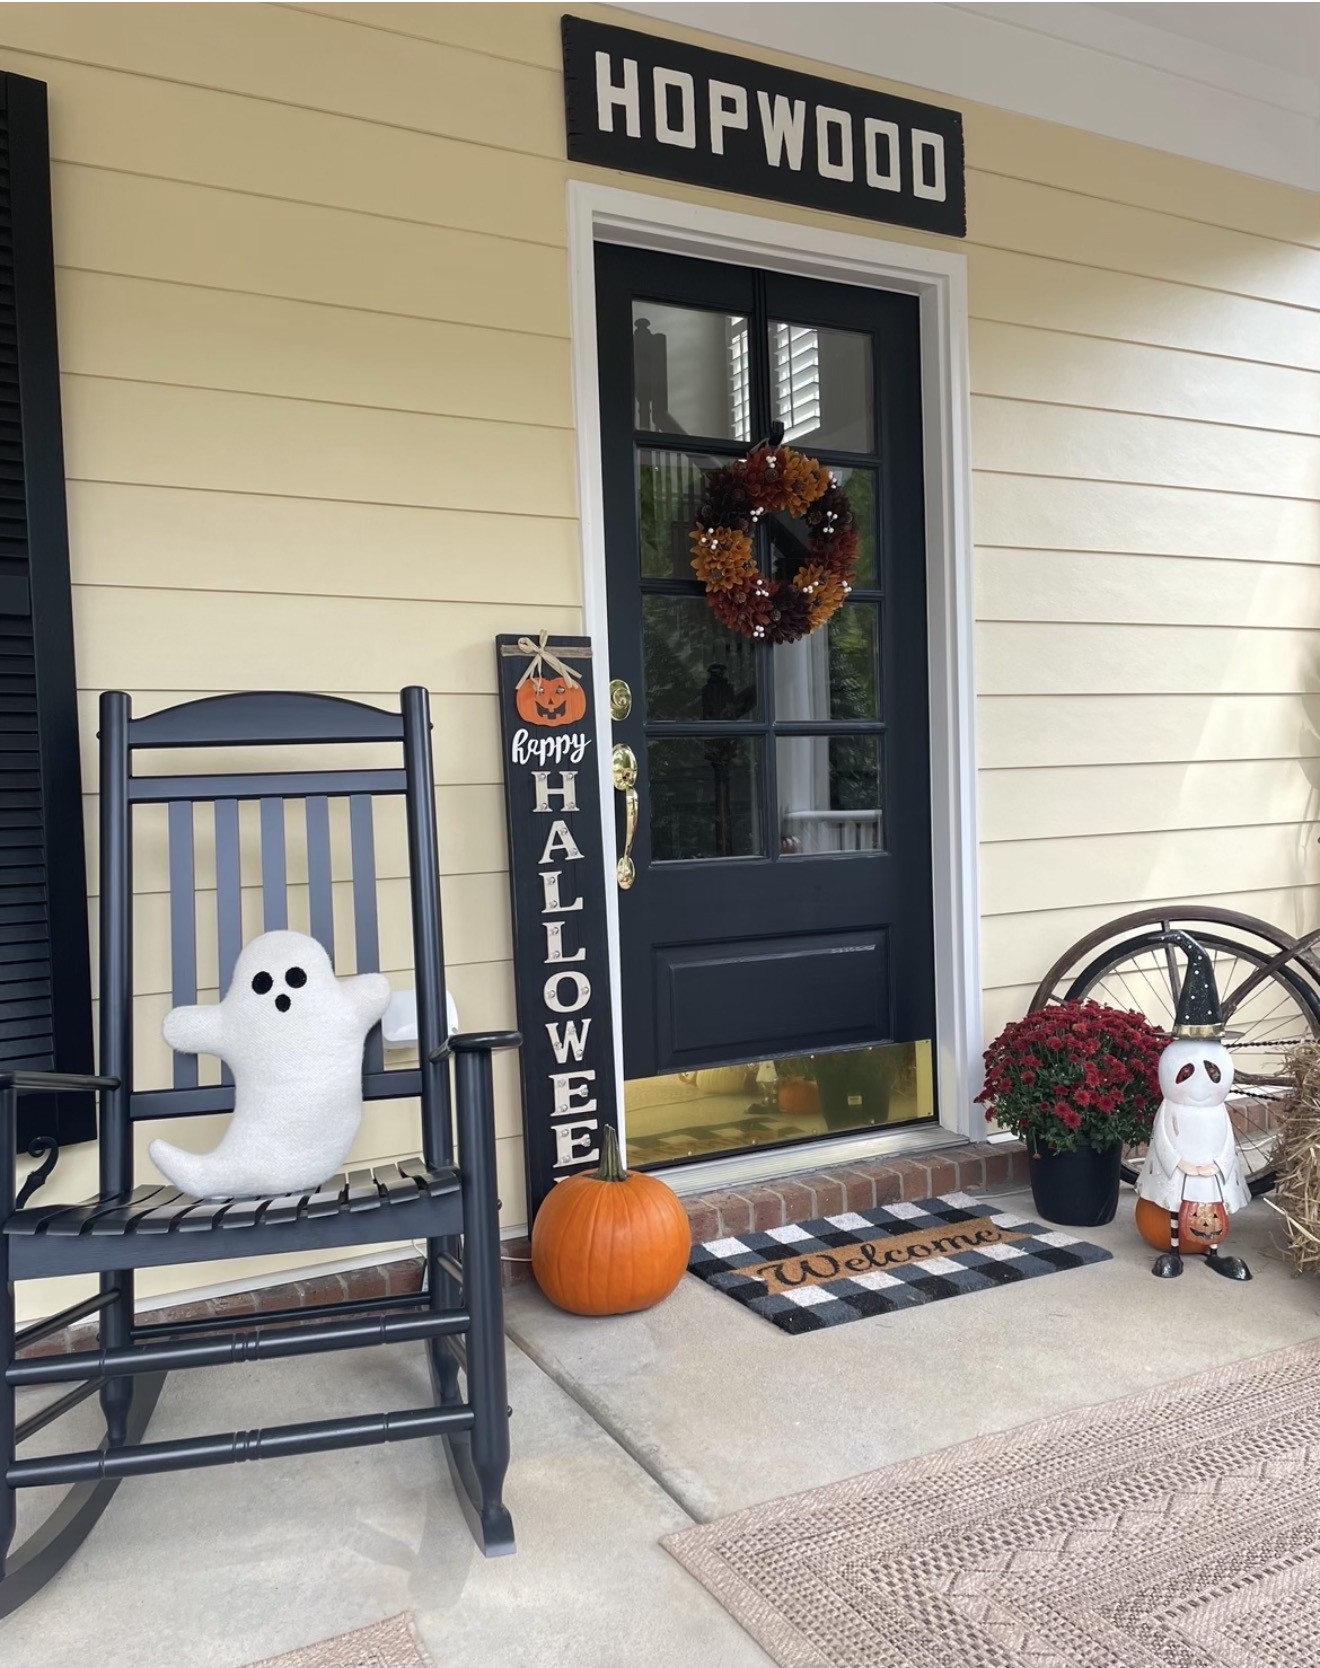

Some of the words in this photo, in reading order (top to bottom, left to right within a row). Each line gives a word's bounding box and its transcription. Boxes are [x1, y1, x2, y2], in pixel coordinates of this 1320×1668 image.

[595, 51, 946, 202] HOPWOOD
[512, 728, 592, 767] happy
[531, 771, 600, 1184] HALLOWEE
[757, 1228, 1003, 1286] Welcome
